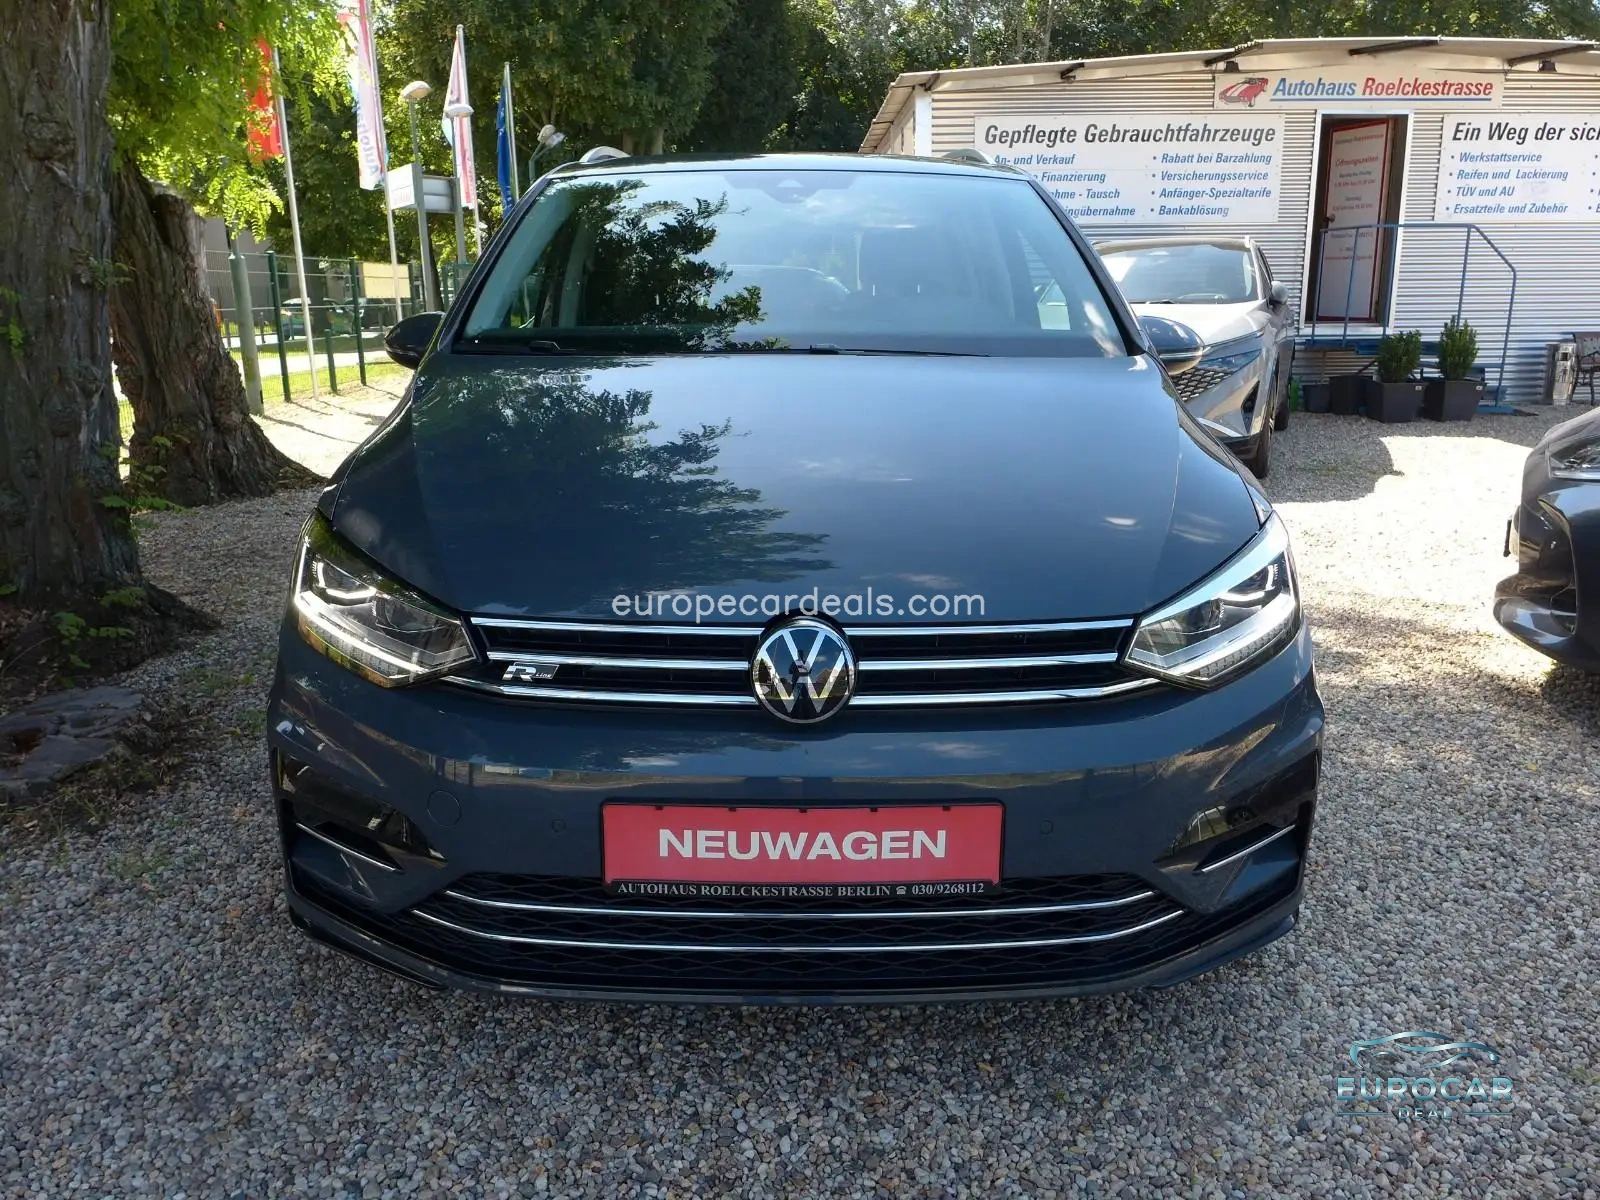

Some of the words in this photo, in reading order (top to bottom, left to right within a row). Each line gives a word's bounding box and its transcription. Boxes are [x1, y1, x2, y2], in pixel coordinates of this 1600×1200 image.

[1272, 77, 1357, 96] Autohaus
[1362, 77, 1493, 96] Roelckestrasse
[985, 124, 1077, 148] Gepflegte
[1084, 123, 1276, 146] Gebrauchtfahrzeuge
[1452, 122, 1481, 141] Ein
[1488, 122, 1529, 145] Weg
[1534, 122, 1565, 141] der
[1013, 154, 1033, 165] und
[1036, 153, 1076, 165] Verkauf
[1161, 153, 1195, 164] Rabatt
[1197, 152, 1213, 164] bei
[1216, 152, 1272, 165] Barzahlung
[1459, 152, 1543, 163] Werkstattservice
[1041, 171, 1106, 184] Finanzierung
[1161, 169, 1269, 183] Versicherungsservice
[1457, 169, 1489, 180] Reifen
[1491, 169, 1511, 180] und
[1516, 168, 1569, 182] Lackierung
[1086, 188, 1120, 200] Tausch
[1159, 186, 1272, 200] Anfänger-Spezialtarife
[1456, 184, 1477, 197] TÜV
[1478, 187, 1498, 197] und
[1498, 186, 1516, 197] AU
[1158, 204, 1229, 218] Bankablösung
[1453, 203, 1505, 214] Ersatzteile
[1508, 203, 1527, 214] und
[1528, 202, 1569, 214] Zubehör
[659, 828, 947, 860] NEUWAGEN
[618, 883, 697, 895] AUTOHAUS
[701, 885, 833, 897] ROELCKESTRASSE
[837, 885, 891, 897] BERLIN
[911, 882, 984, 896] 030/9268112
